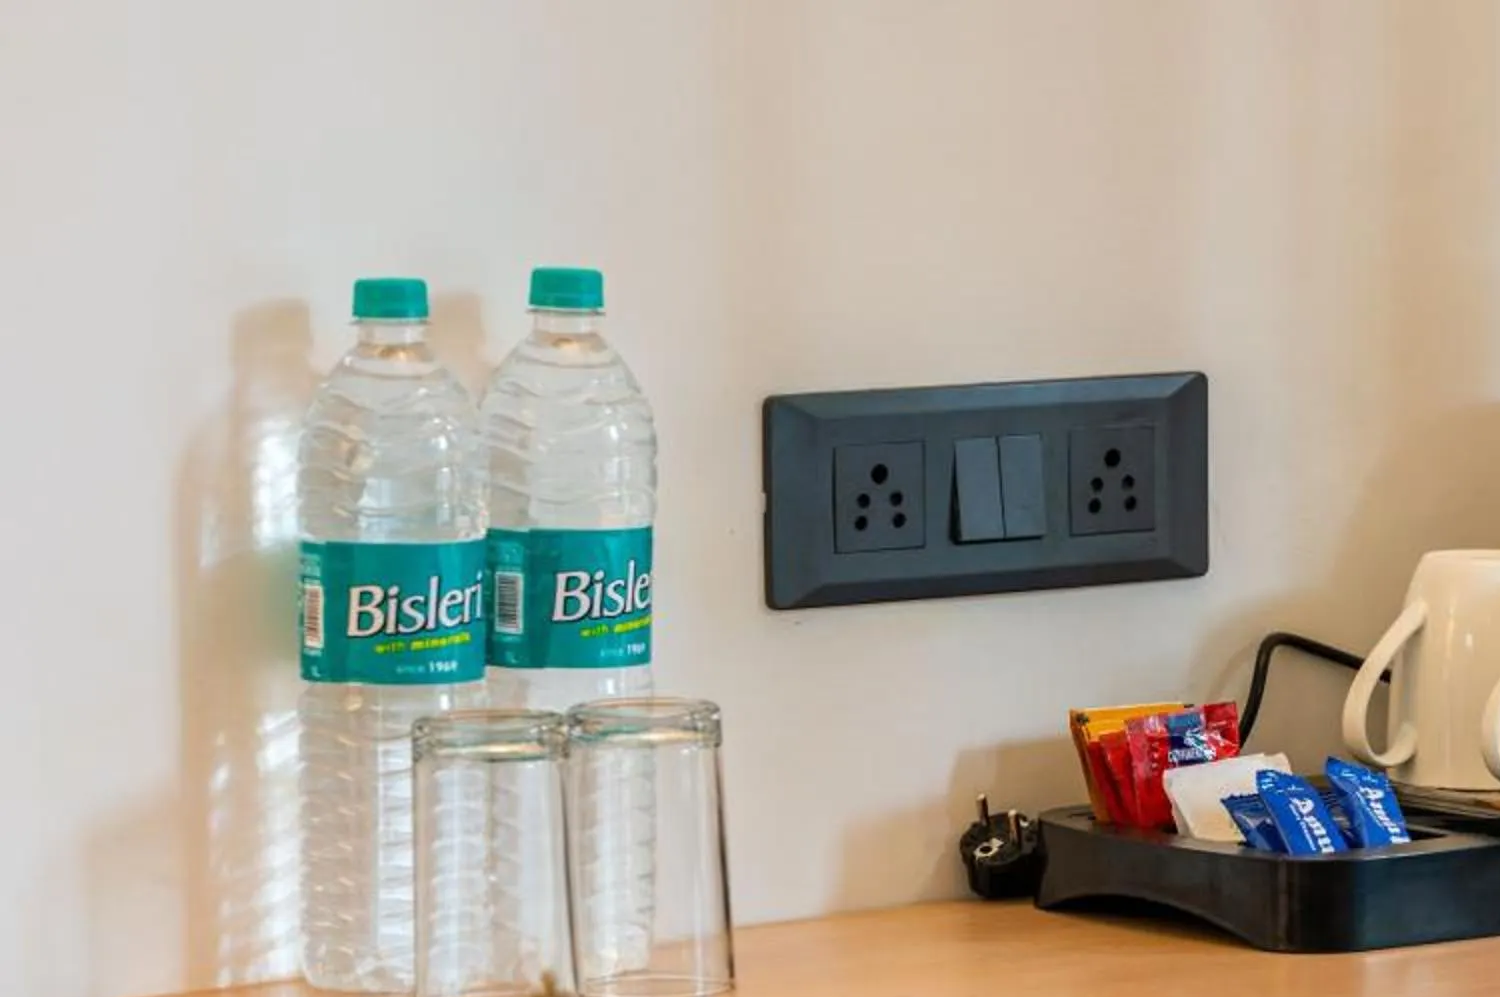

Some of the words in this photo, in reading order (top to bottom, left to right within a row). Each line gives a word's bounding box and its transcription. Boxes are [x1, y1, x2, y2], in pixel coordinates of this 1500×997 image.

[346, 571, 483, 638] Bisleri
[552, 559, 652, 622] Bisle
[1288, 796, 1335, 854] Amu
